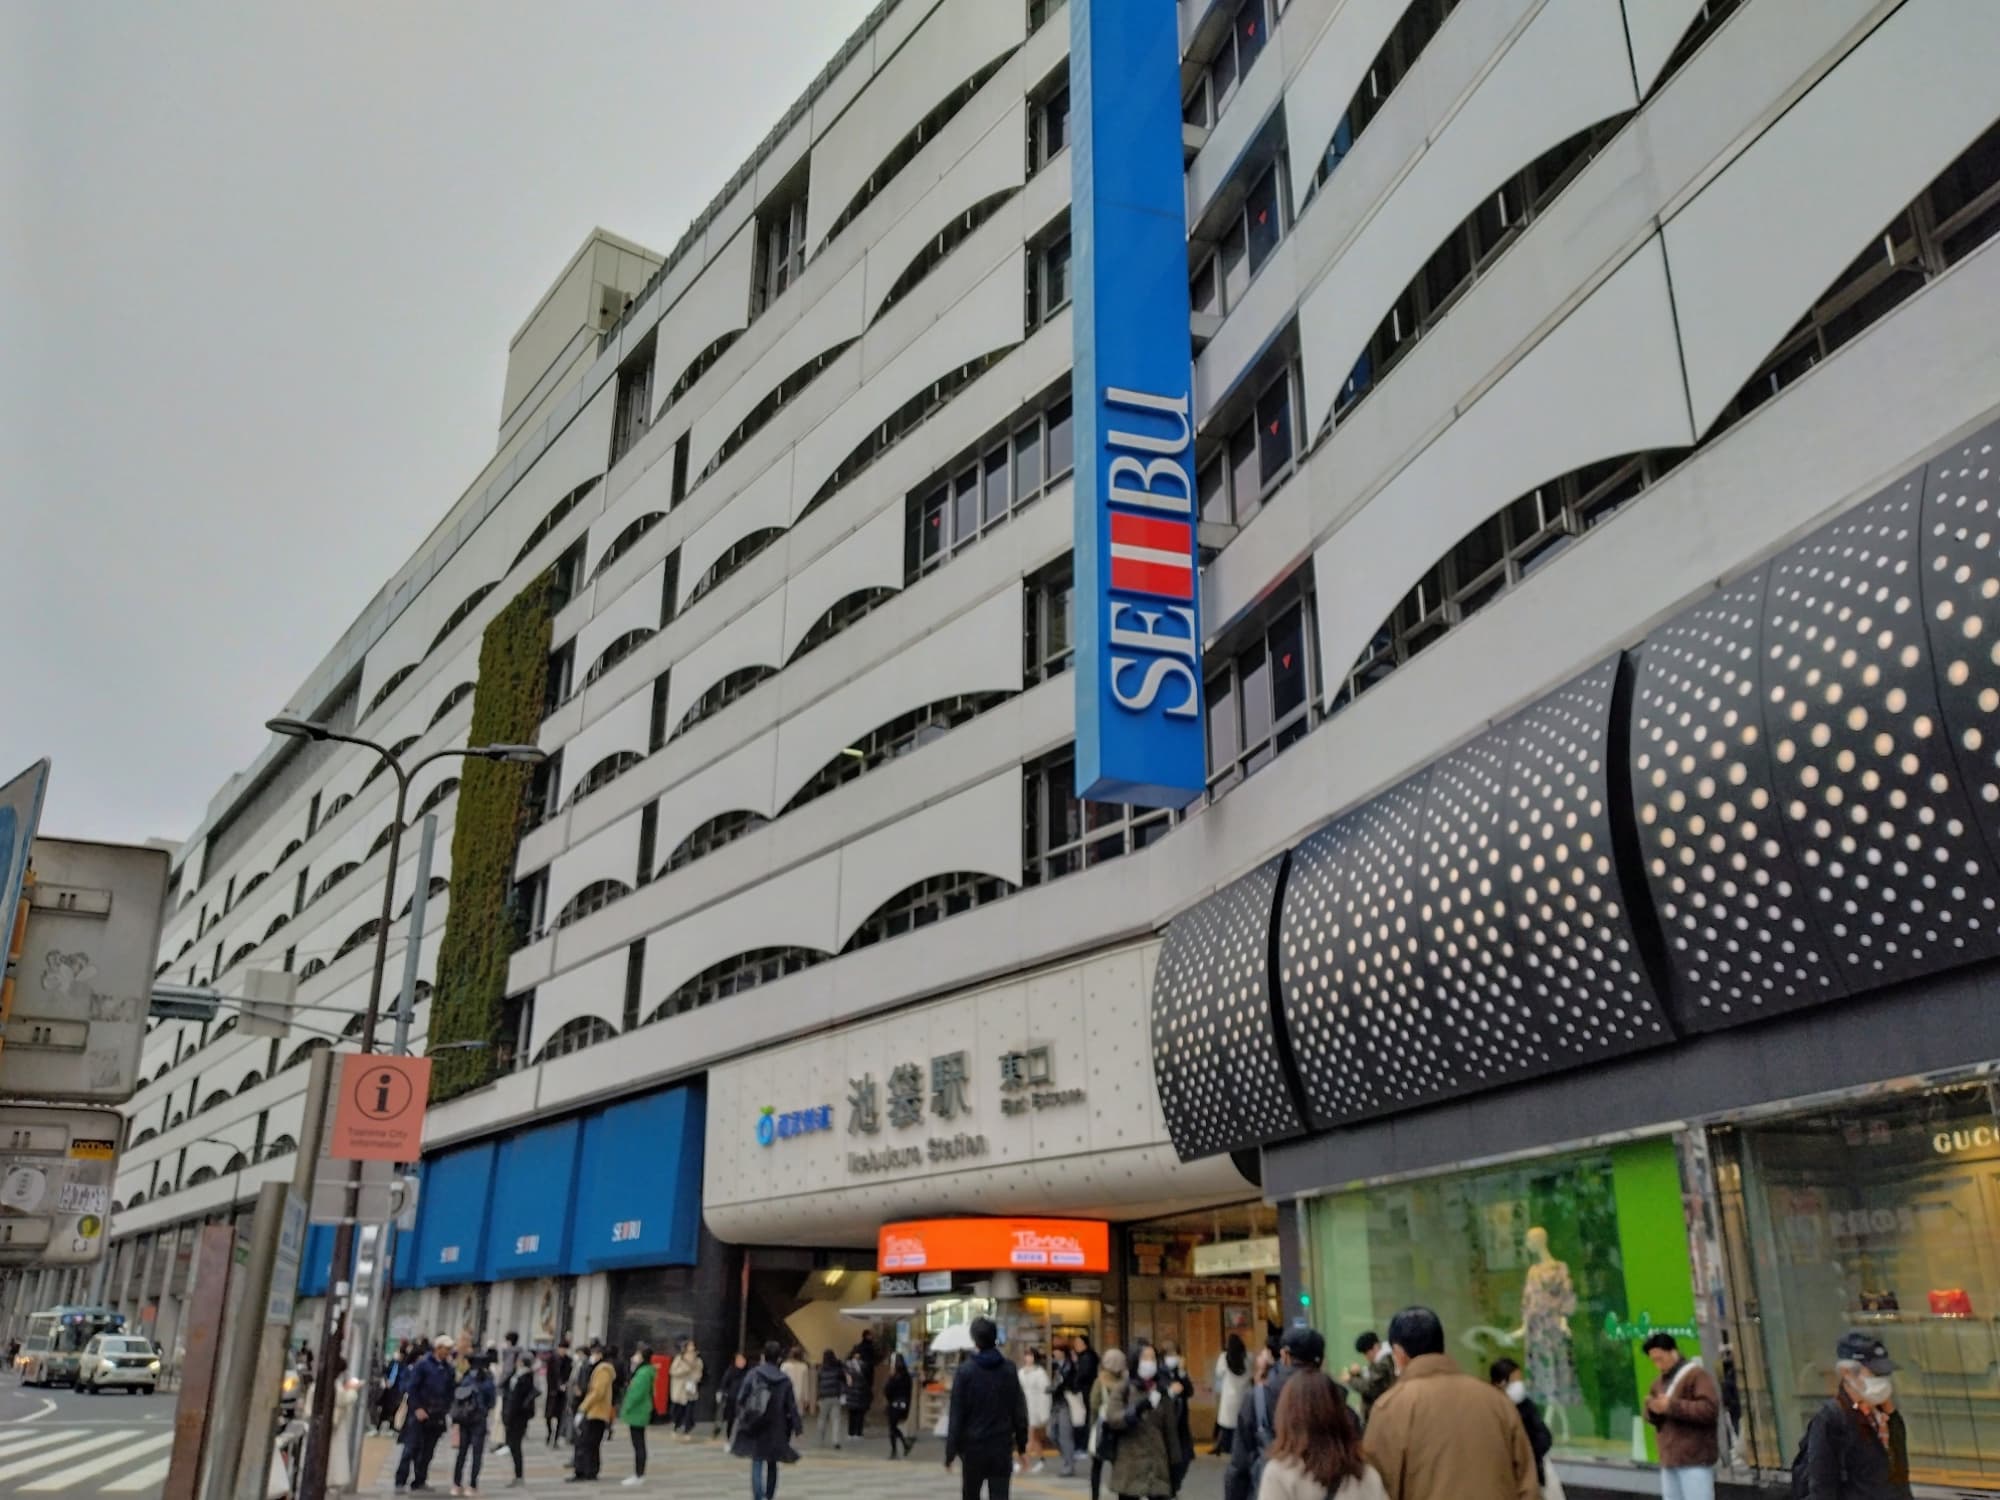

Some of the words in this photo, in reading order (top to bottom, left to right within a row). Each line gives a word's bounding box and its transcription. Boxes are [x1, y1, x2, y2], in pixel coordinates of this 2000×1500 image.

[1106, 387, 1198, 717] SEIBU
[847, 1050, 972, 1136] 池袋駅
[999, 1045, 1055, 1092] 東口
